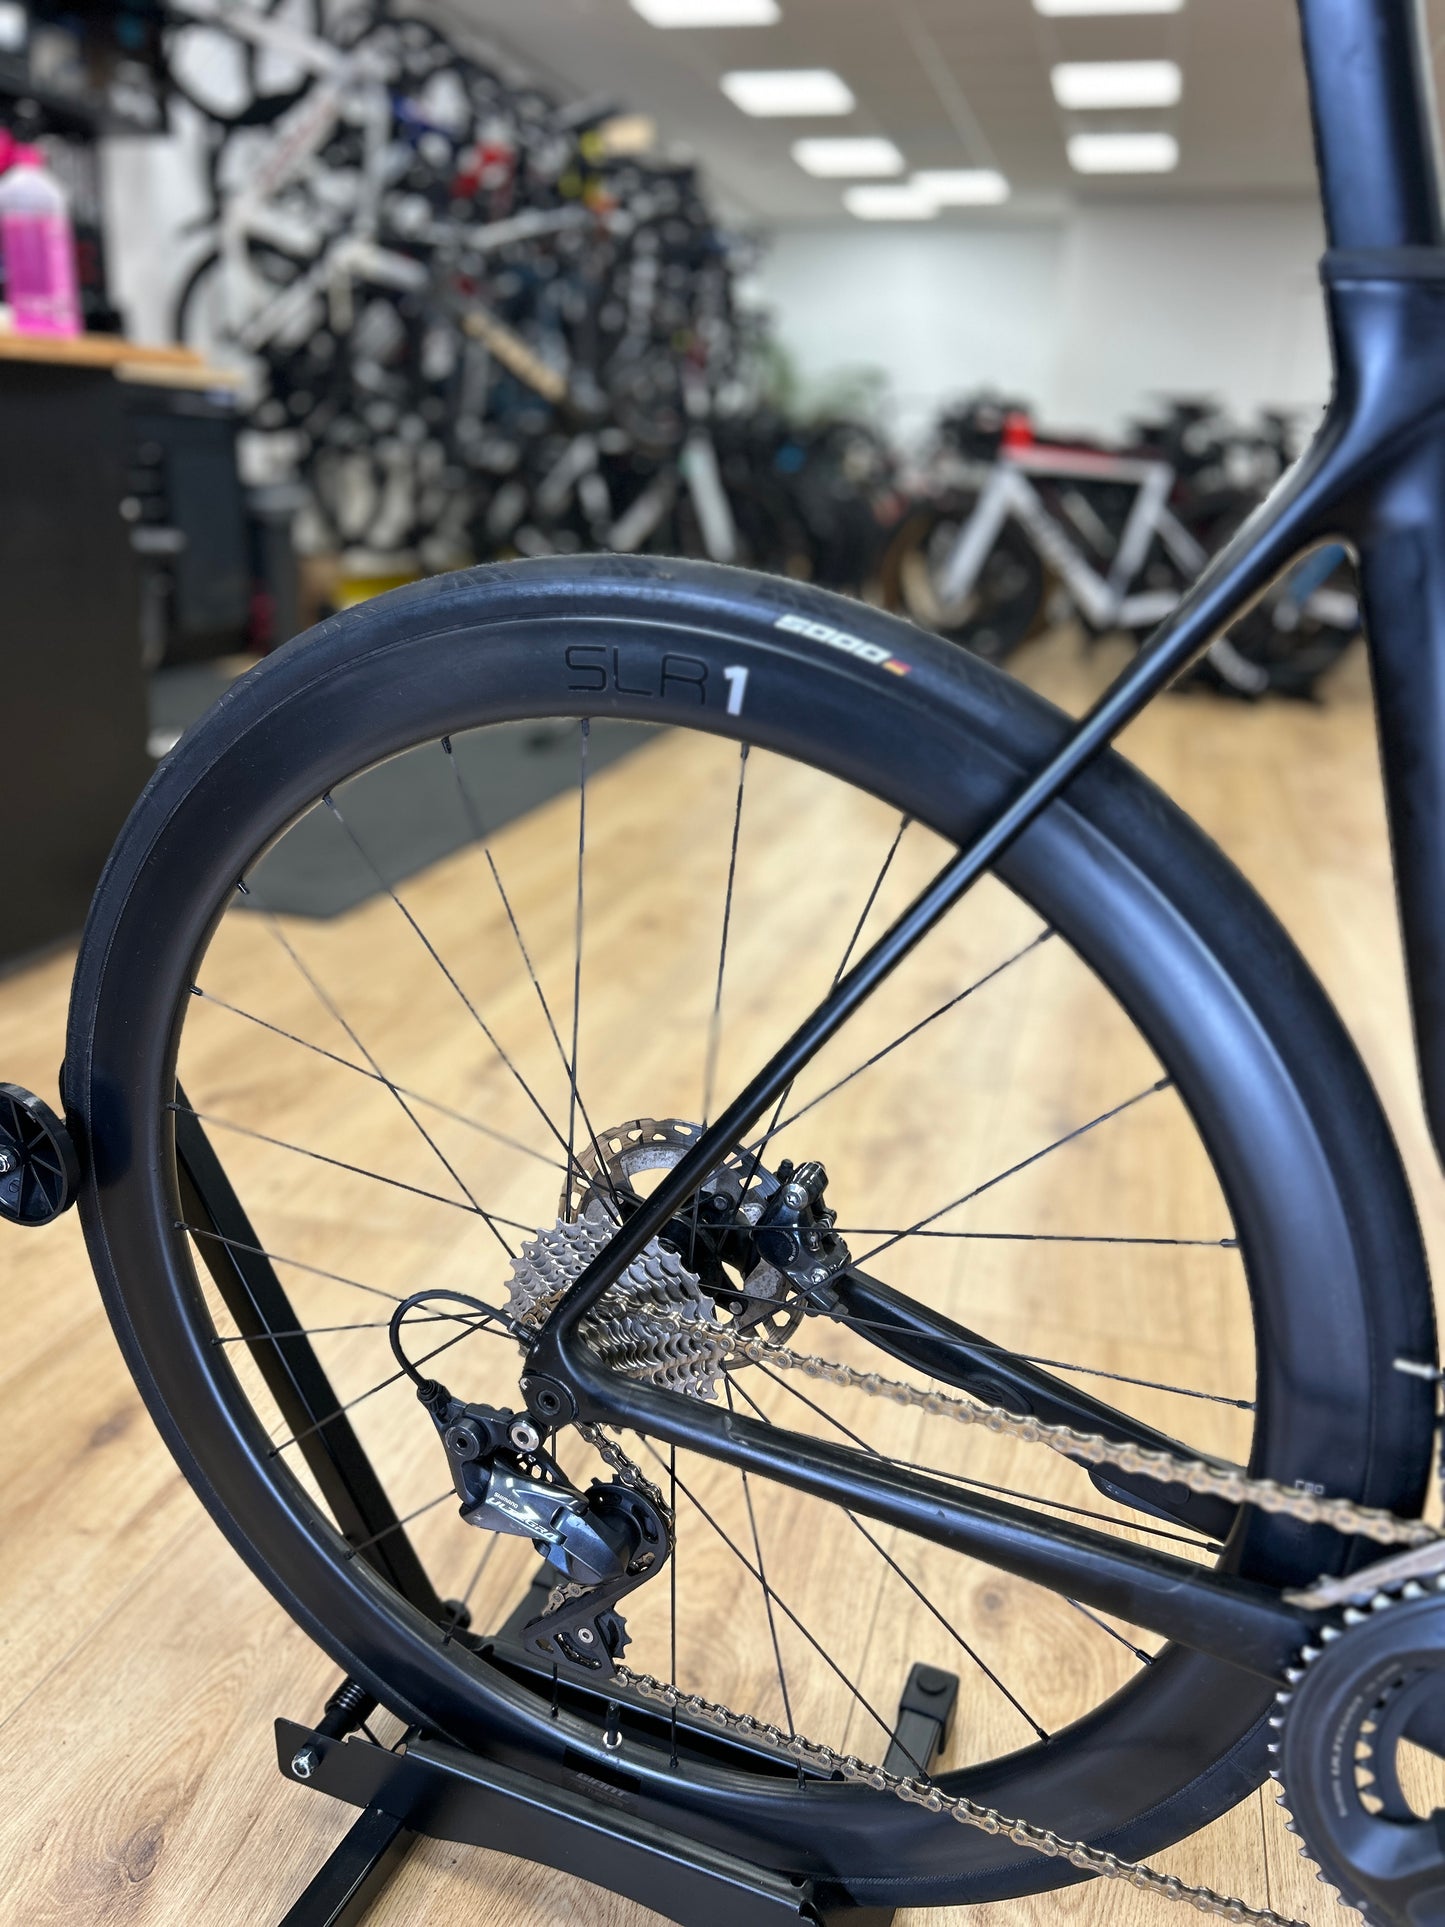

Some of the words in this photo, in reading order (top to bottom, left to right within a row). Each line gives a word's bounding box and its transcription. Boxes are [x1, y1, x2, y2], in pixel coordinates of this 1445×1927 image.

[774, 614, 892, 665] 5000
[564, 644, 709, 705] SLR
[723, 665, 749, 717] 1
[493, 1491, 519, 1509] SHIMANO
